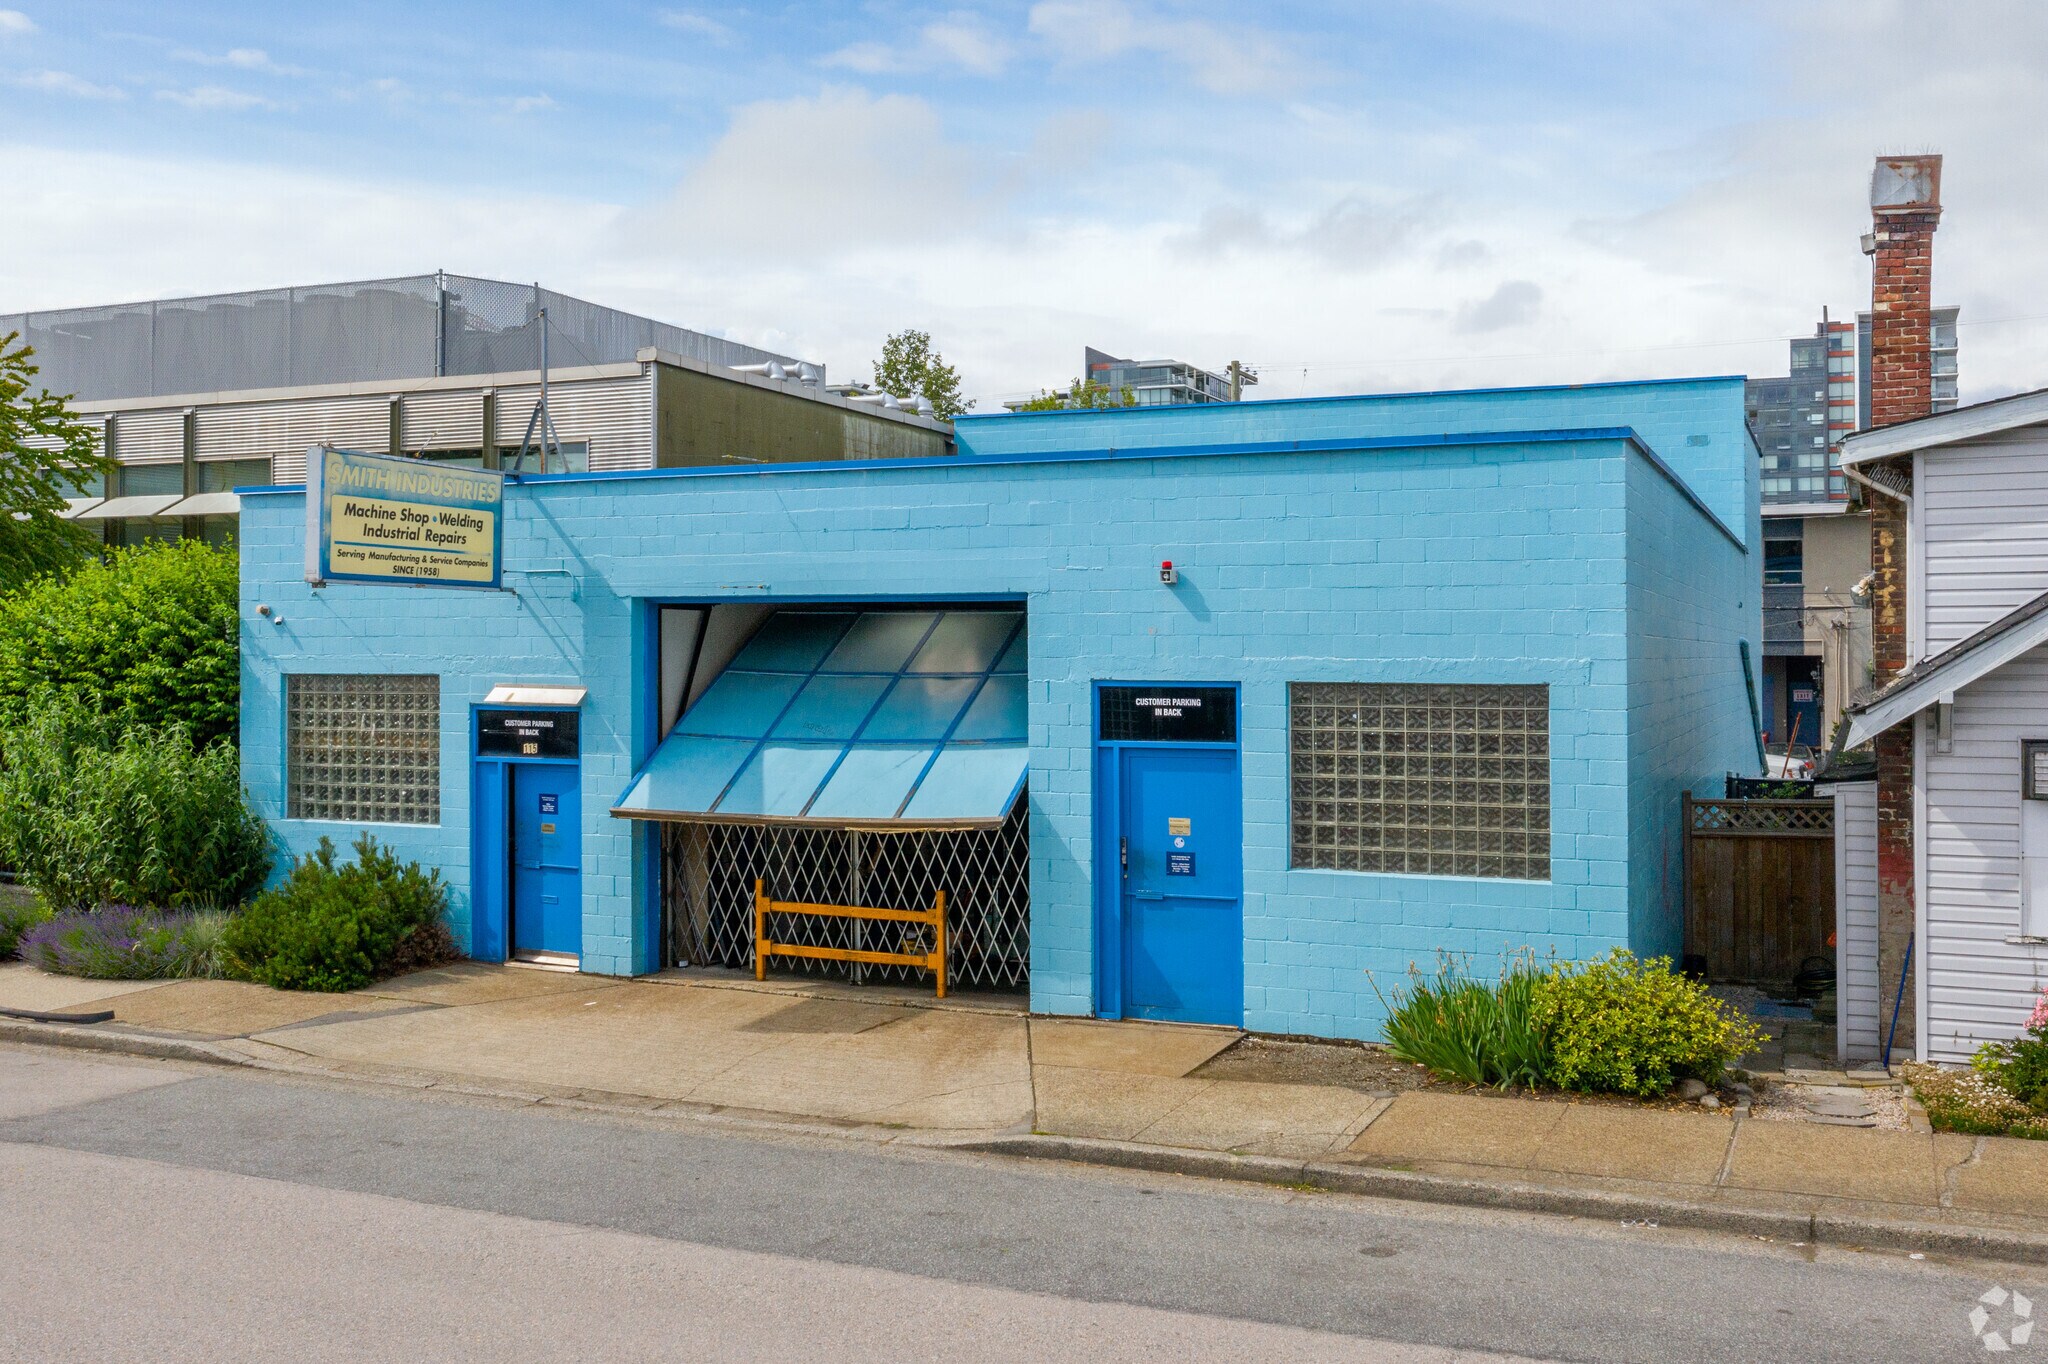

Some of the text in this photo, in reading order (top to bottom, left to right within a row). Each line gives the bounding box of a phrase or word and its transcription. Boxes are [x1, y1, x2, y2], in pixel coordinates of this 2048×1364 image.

[328, 462, 497, 503] SMITH INDUSTRIES
[344, 502, 484, 532] Machine Shop Welding
[363, 523, 467, 546] Industrial Repairs
[337, 549, 489, 568] Serving Manufacturing & Service Companies
[392, 565, 440, 577] SINCE (1958)
[1135, 698, 1201, 707] CUSTOMER PARKING
[1155, 708, 1182, 717] IN BACK
[505, 719, 554, 728] CUSTOMER PARKING
[523, 742, 538, 754] 115
